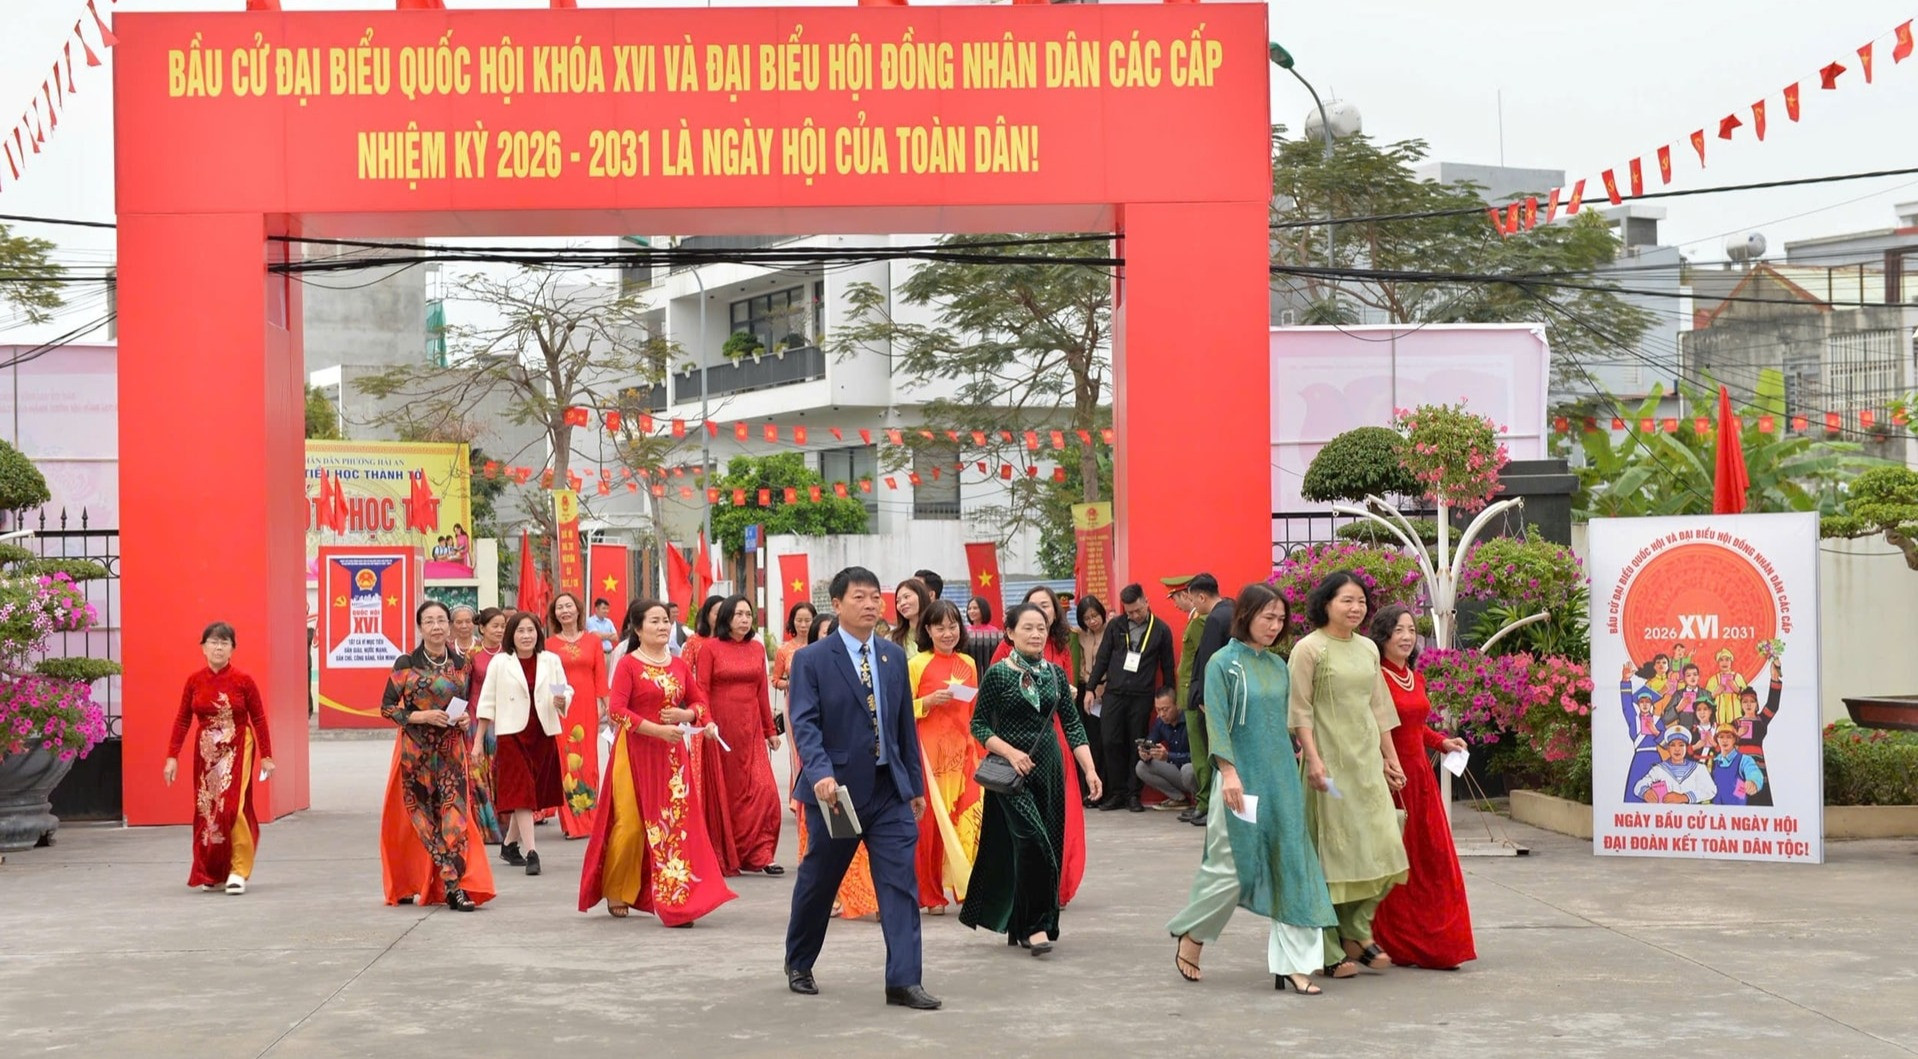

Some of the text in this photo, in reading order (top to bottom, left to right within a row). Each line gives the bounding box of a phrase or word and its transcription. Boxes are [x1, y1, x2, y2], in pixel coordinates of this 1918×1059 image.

[168, 22, 1223, 106] BẦU CỬ ĐẠI BIỂU QUỐC HỘI KHÓA XVI VÀ ĐẠI BIỂU HỘI ĐỒNG NHÂN DÂN CÁC CẤP
[357, 110, 1040, 190] NHIỆM KỲ 2026 - 2031 LÀ NGÀY HỘI CỦA TOÀN DÂN!
[335, 469, 360, 481] HỌC
[364, 467, 403, 480] THÀNH
[349, 497, 395, 539] HỌC
[402, 498, 440, 532] TT
[1606, 526, 1793, 634] BẦU CỬ ĐẠI BIỂU QUỐC HỘI VÀ ĐẠI BIỂU HỘI ĐỒNG NHÂN DÂN CÁC CẤP
[353, 616, 379, 634] XVI
[1644, 614, 1755, 640] 2026 XVI 2031
[1614, 810, 1798, 836] NGÀY BẦU CỬ LÀ NGÀY HỘI
[1603, 832, 1809, 858] ĐẠI ĐOÀN KẾT TOÀN DÂN TỘC!
